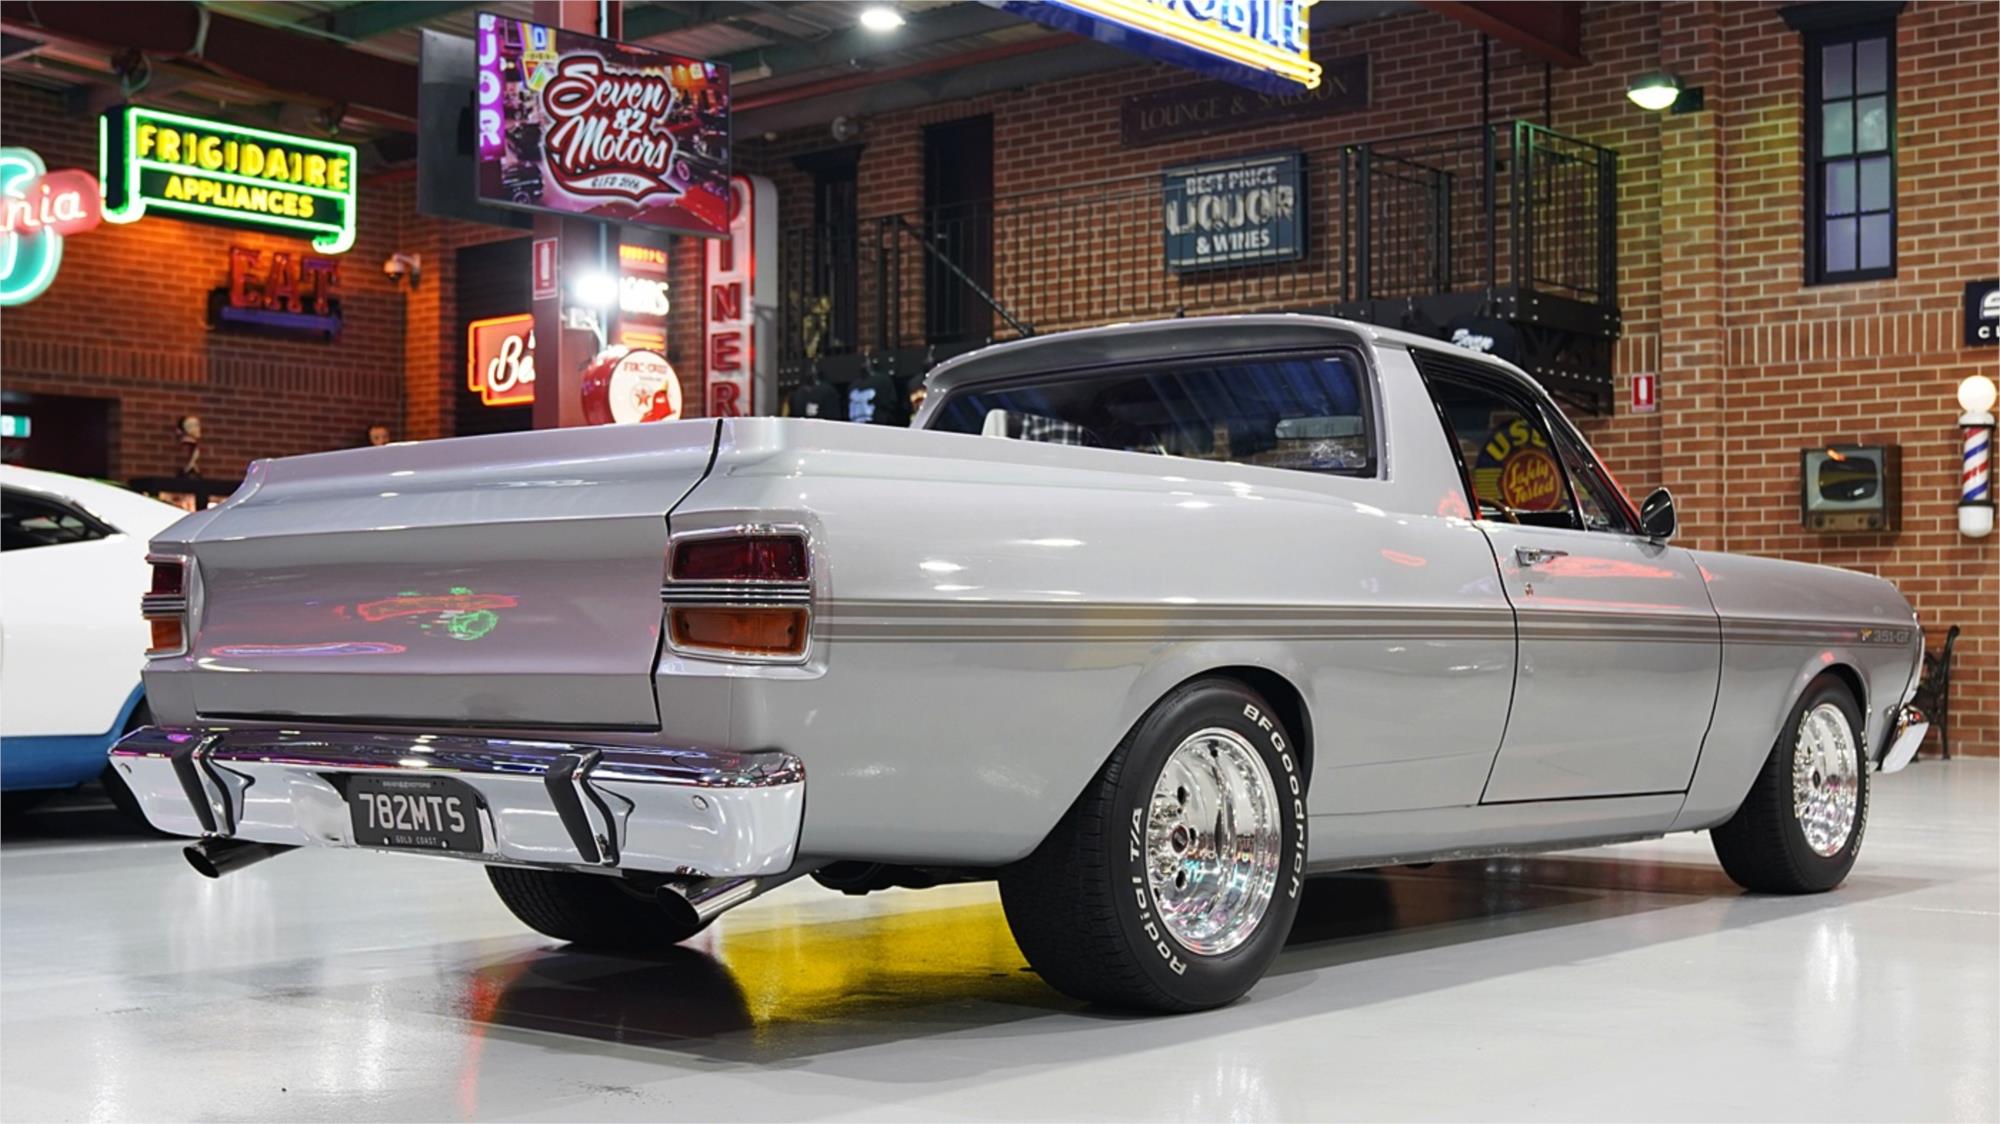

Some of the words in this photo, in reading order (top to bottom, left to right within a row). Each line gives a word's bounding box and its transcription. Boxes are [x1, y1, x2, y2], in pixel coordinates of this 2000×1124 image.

[549, 63, 665, 117] Seven
[613, 108, 647, 134] 82
[1139, 98, 1223, 131] LOUNGE
[1230, 97, 1246, 116] &
[137, 124, 348, 190] FRIGIDAIRE
[551, 115, 668, 170] Motors
[164, 175, 315, 218] APPLIANCES
[1185, 172, 1227, 196] BEST
[1227, 165, 1277, 190] PRICE
[1166, 184, 1295, 236] LIQUOR
[1196, 236, 1210, 255] &
[1212, 229, 1270, 253] WINES
[230, 246, 338, 315] EAT
[1513, 475, 1555, 505] Tested
[358, 793, 466, 833] 782MTS
[1129, 807, 1143, 862] T/A
